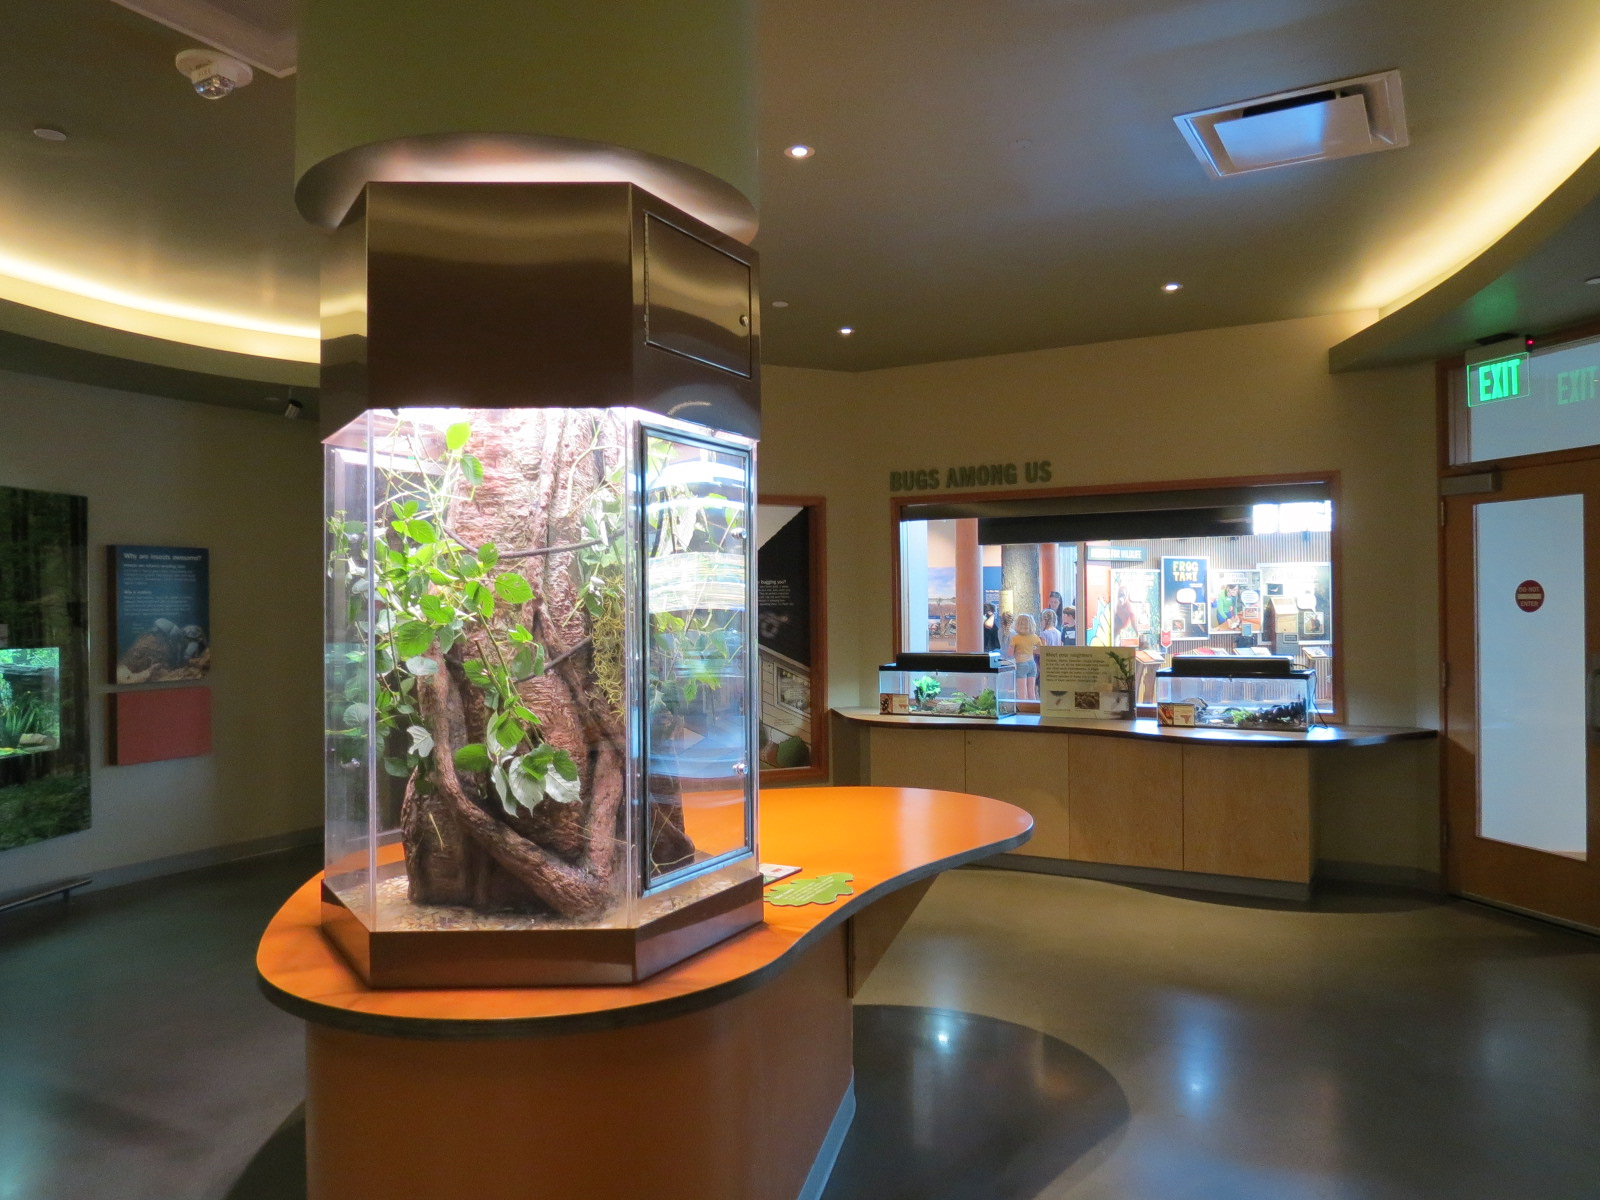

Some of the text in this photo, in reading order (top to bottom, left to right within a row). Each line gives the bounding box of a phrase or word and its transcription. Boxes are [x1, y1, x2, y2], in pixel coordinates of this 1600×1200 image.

[1478, 358, 1521, 402] EXIT
[1557, 365, 1598, 405] EXIT
[889, 460, 1052, 492] BUGS AMONG US
[123, 552, 137, 560] Why
[1172, 560, 1199, 572] FROG
[1173, 571, 1198, 582] TAXI
